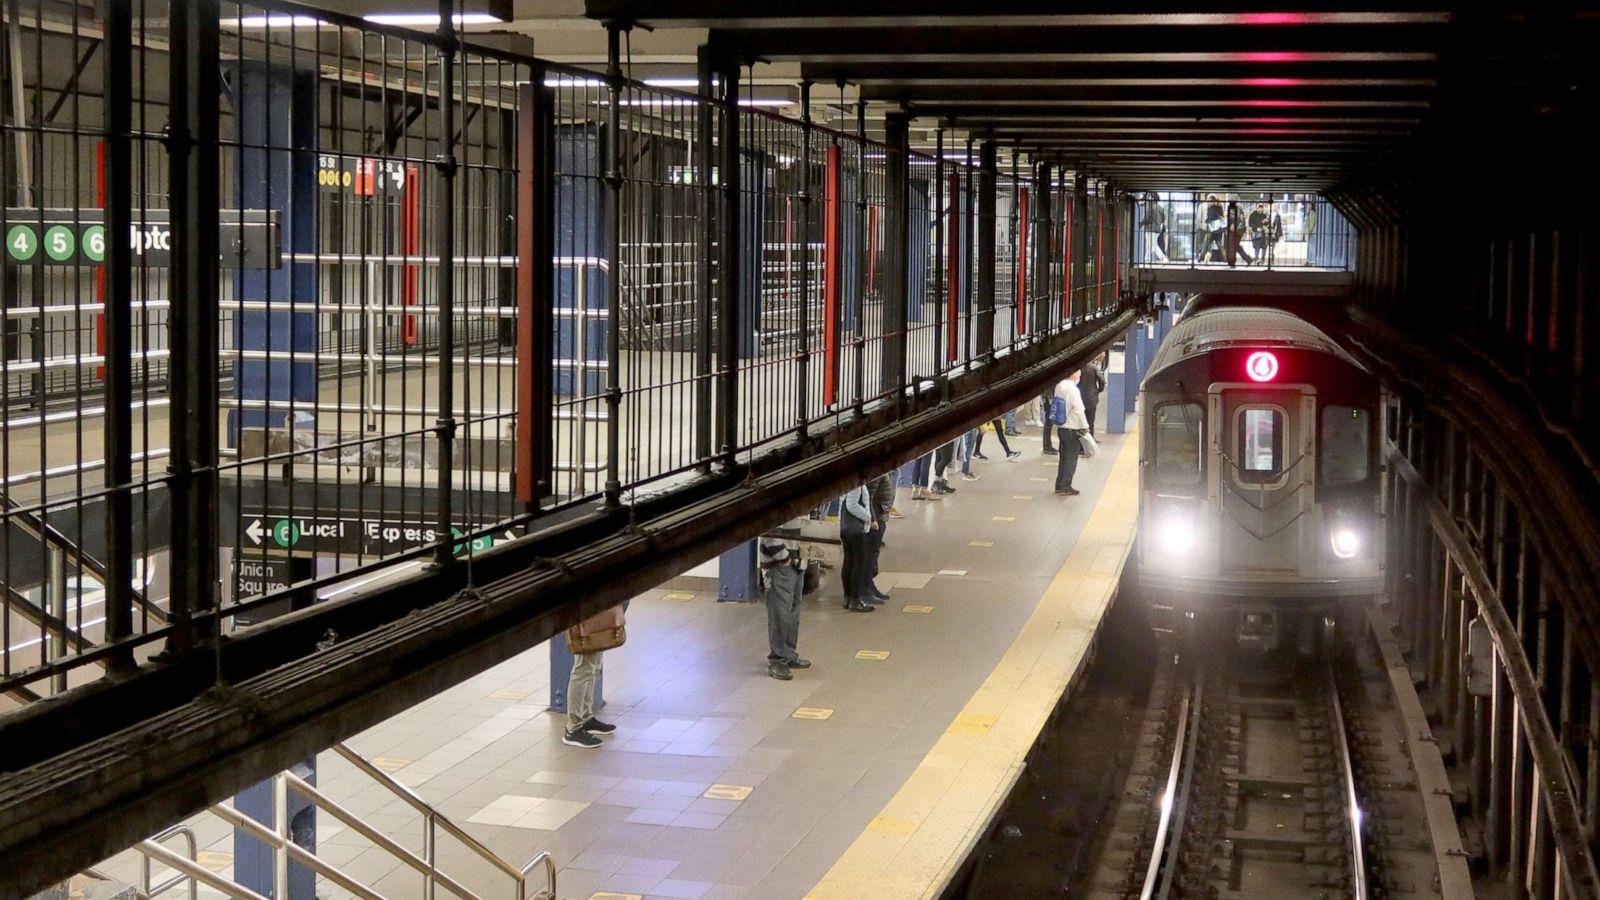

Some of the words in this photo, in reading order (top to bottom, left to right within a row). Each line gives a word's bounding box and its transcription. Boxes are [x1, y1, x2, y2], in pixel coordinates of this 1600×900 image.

[14, 233, 28, 252] 4
[53, 233, 67, 252] 5
[90, 233, 105, 252] 6
[300, 520, 344, 537] Local
[368, 523, 436, 543] Expess
